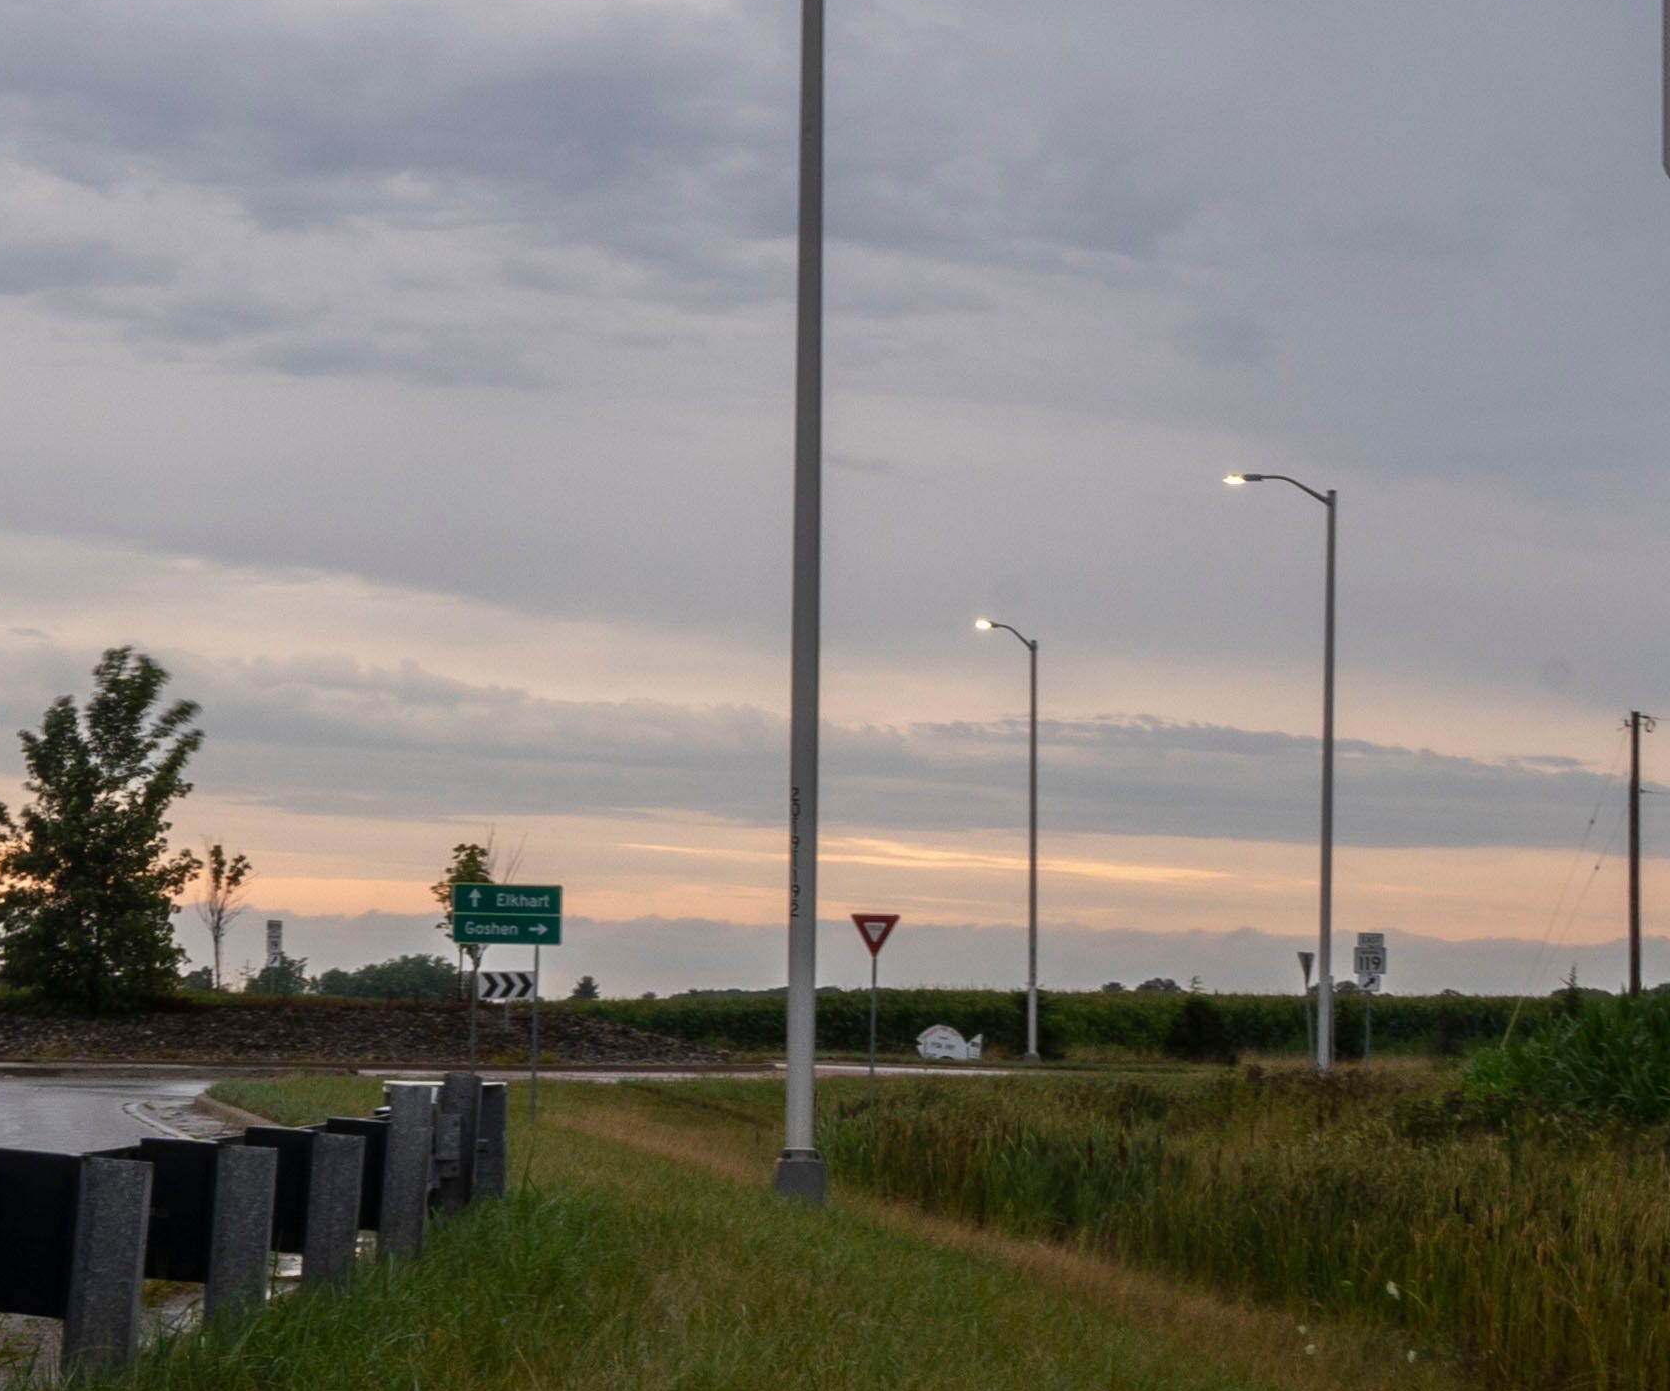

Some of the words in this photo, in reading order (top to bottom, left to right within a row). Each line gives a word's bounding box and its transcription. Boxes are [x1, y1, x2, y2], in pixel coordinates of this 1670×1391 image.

[496, 893, 550, 908] Elkhart
[464, 921, 519, 936] Goshen
[1359, 956, 1381, 971] 119
